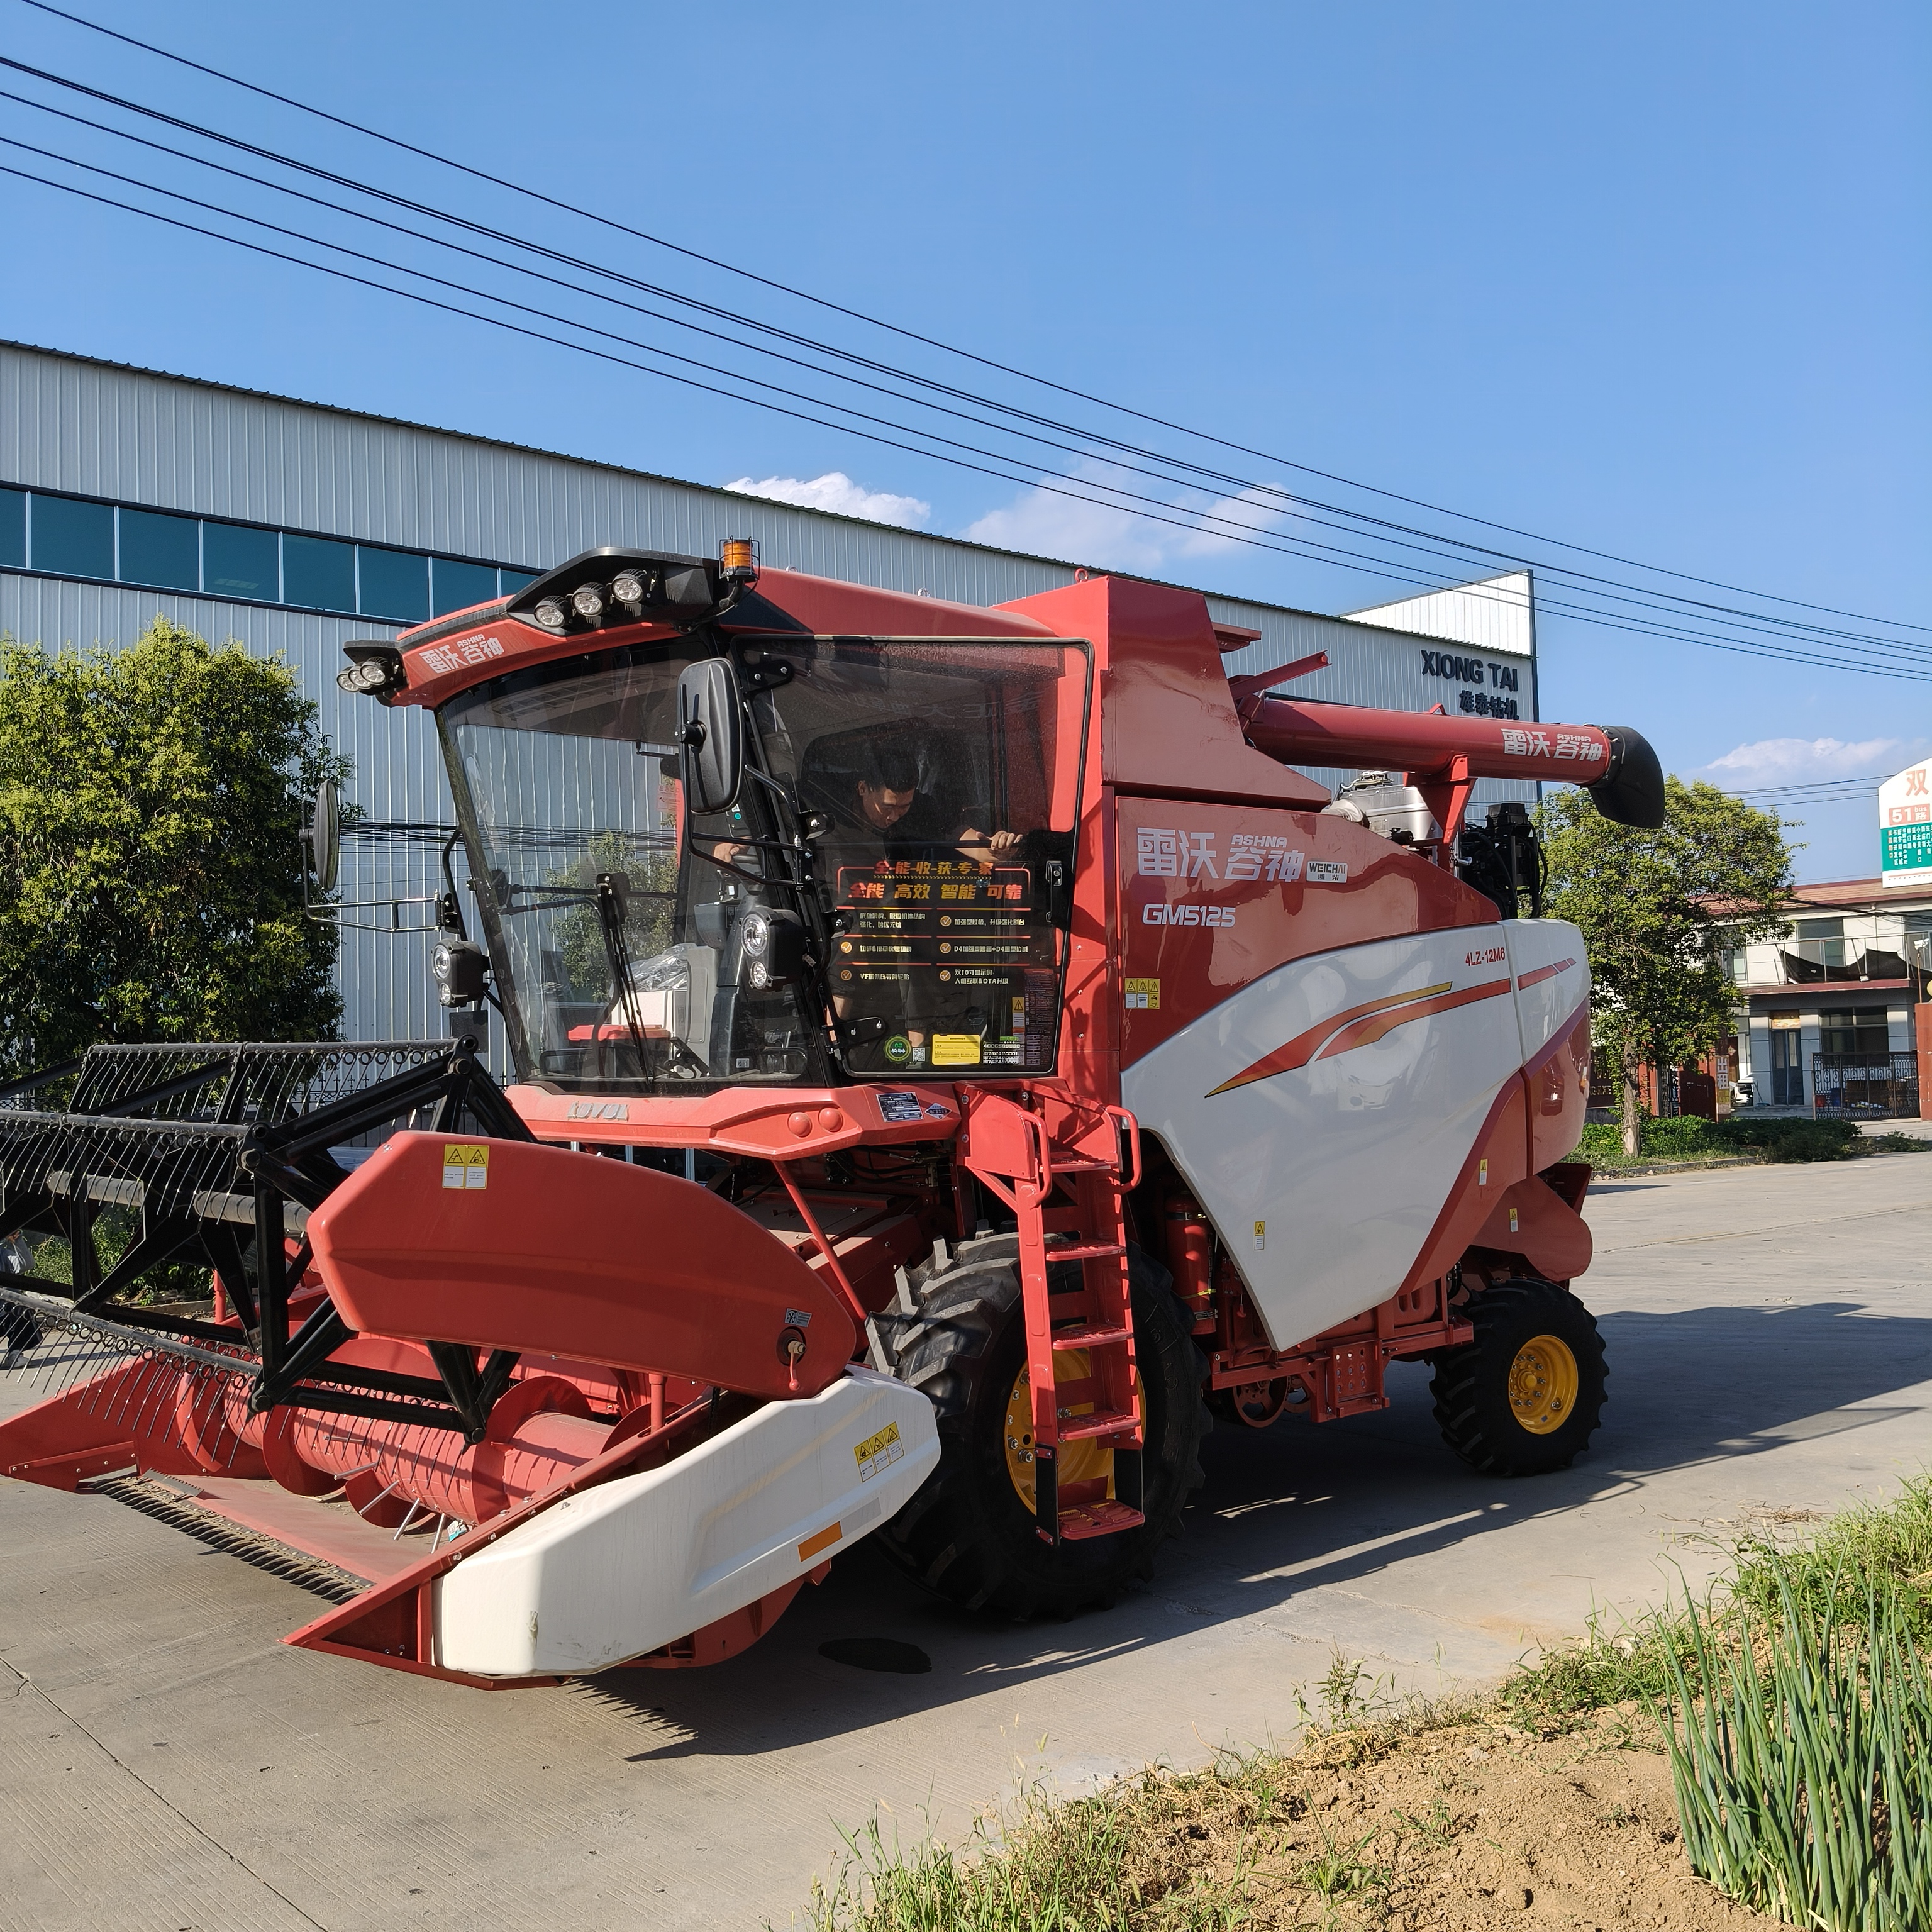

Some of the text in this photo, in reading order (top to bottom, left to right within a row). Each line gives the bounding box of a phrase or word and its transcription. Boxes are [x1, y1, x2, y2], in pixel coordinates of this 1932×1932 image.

[457, 634, 485, 648] ASHNA
[1421, 650, 1518, 692] XIONG TAI
[1557, 733, 1591, 742] ASHNA
[1906, 769, 1929, 796] 双
[1231, 834, 1287, 848] ASHNA
[1309, 863, 1346, 874] WEICHAI
[848, 882, 1023, 900] 全能 高效 智能 可靠
[1142, 904, 1236, 928] GM5125
[1465, 947, 1506, 967] 4LZ-12M6
